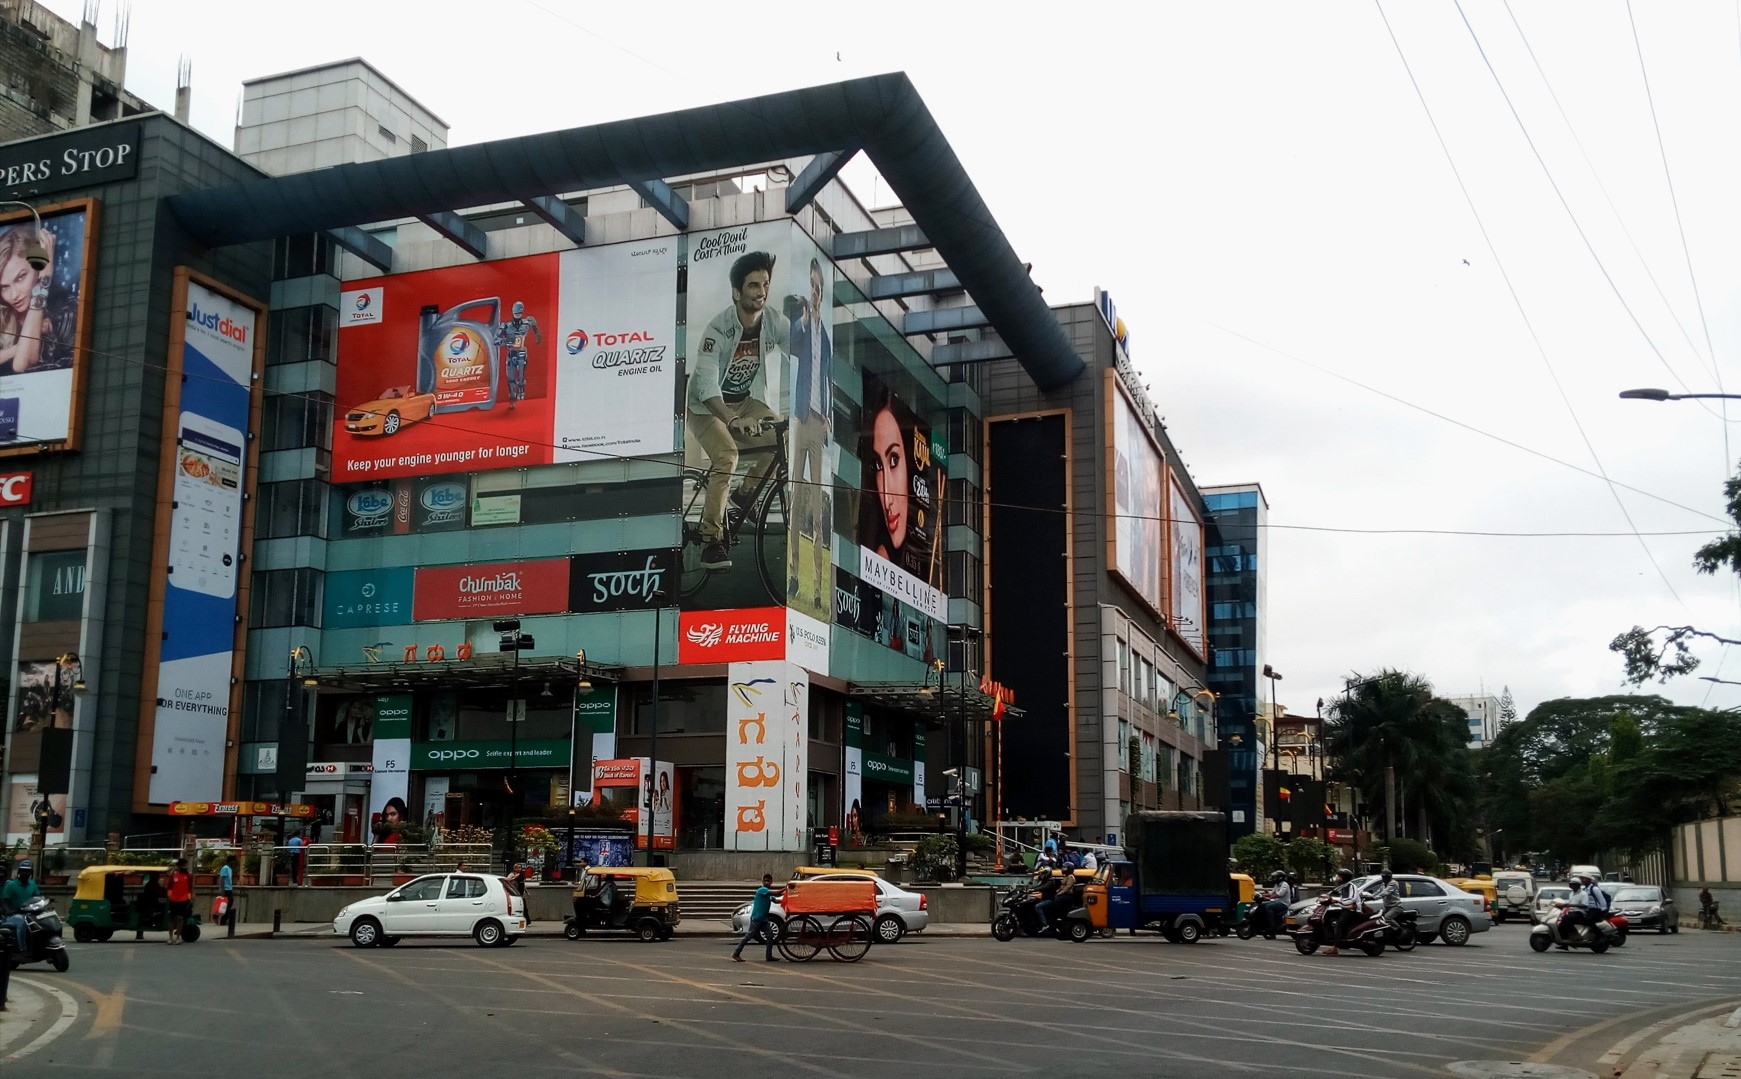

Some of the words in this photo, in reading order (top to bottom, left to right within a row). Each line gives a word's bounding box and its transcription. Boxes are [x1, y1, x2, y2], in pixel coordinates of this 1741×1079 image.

[61, 144, 131, 175] STOP
[352, 312, 374, 320] TOTAL
[592, 331, 655, 347] TOTAL
[447, 355, 472, 364] TOTAL
[591, 346, 667, 369] QUARTZ
[440, 364, 486, 378] QUARTZ
[618, 366, 647, 377] ENGINE
[649, 365, 663, 373] OIL
[347, 459, 371, 471] Keep
[373, 457, 396, 470] your
[398, 452, 431, 468] engine
[434, 448, 475, 464] younger
[478, 446, 493, 459] for
[496, 445, 530, 458] longer
[356, 493, 390, 512] Kobe
[53, 565, 86, 595] AND
[459, 572, 522, 594] Chumbak
[864, 555, 937, 609] MAYBELLINE
[458, 594, 492, 603] FASHION
[499, 592, 522, 601] HOME
[337, 602, 399, 615] CAPRESE
[729, 623, 769, 634] FLYING
[725, 631, 780, 644] MACHINE
[174, 688, 194, 700] ONE
[194, 691, 222, 701] APP
[175, 700, 228, 717] EVERYTHING
[579, 702, 611, 710] oppo
[379, 709, 409, 717] oppo
[428, 749, 480, 761] oppo
[385, 760, 396, 769] F5
[867, 760, 887, 771] oppo
